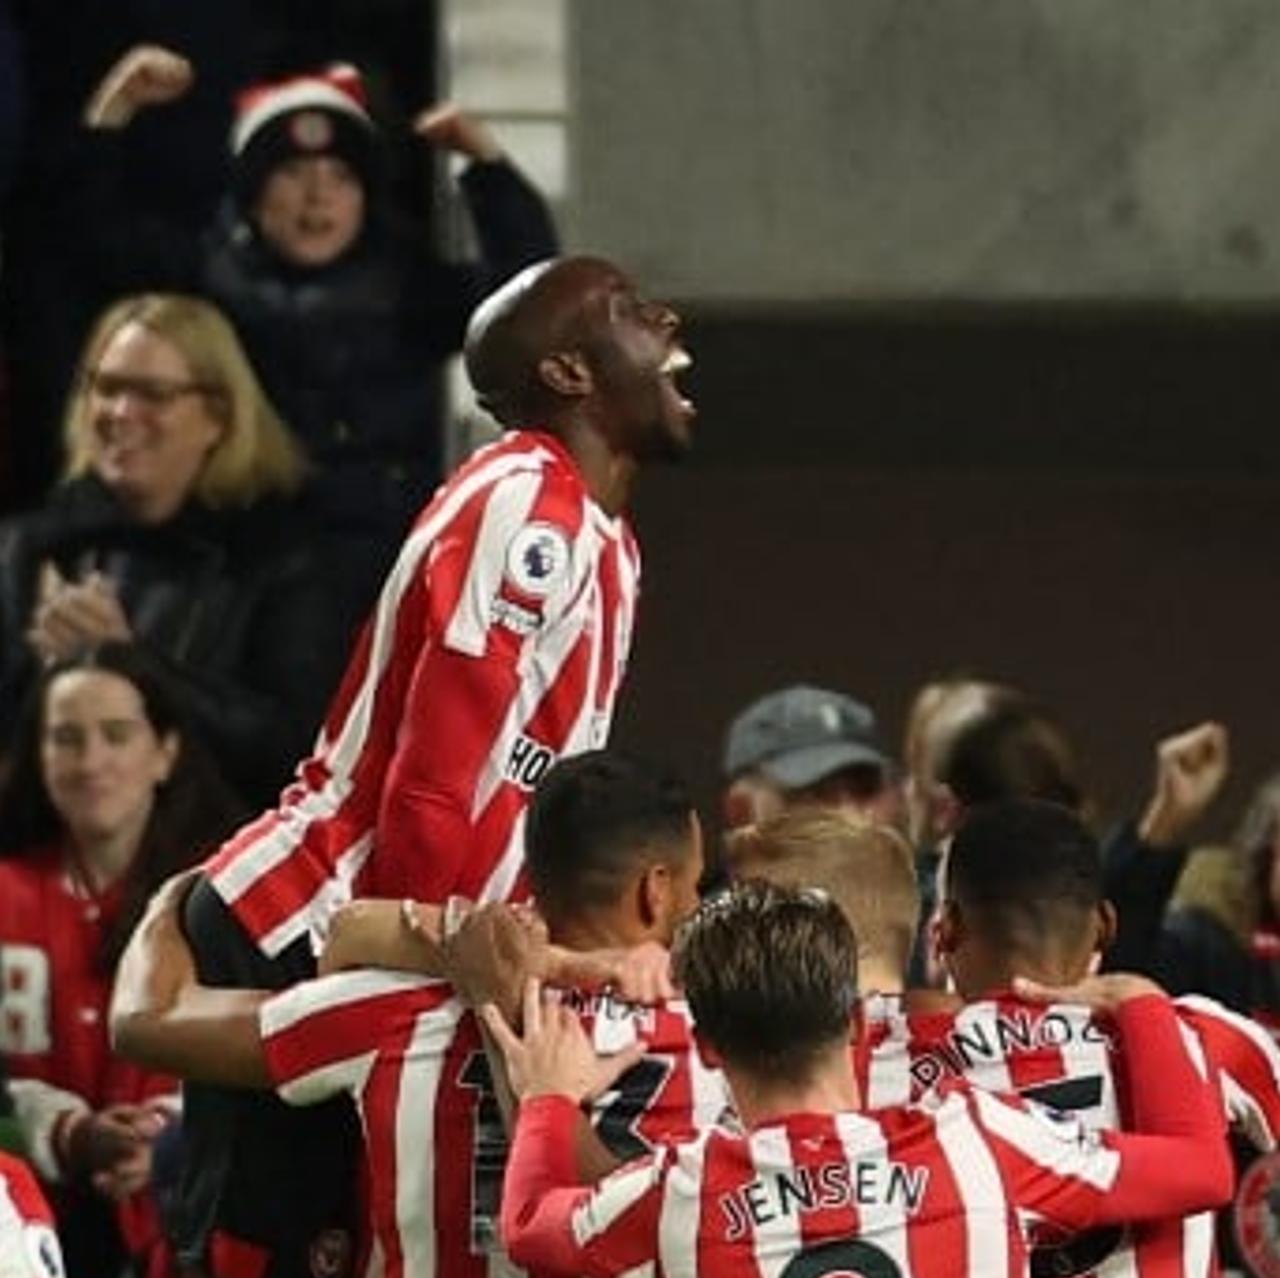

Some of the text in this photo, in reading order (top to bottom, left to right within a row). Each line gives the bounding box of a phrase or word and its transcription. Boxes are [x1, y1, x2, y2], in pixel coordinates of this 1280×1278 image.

[504, 735, 554, 790] HO
[909, 1010, 1112, 1090] PINNOC
[721, 1160, 929, 1241] JENSEN
